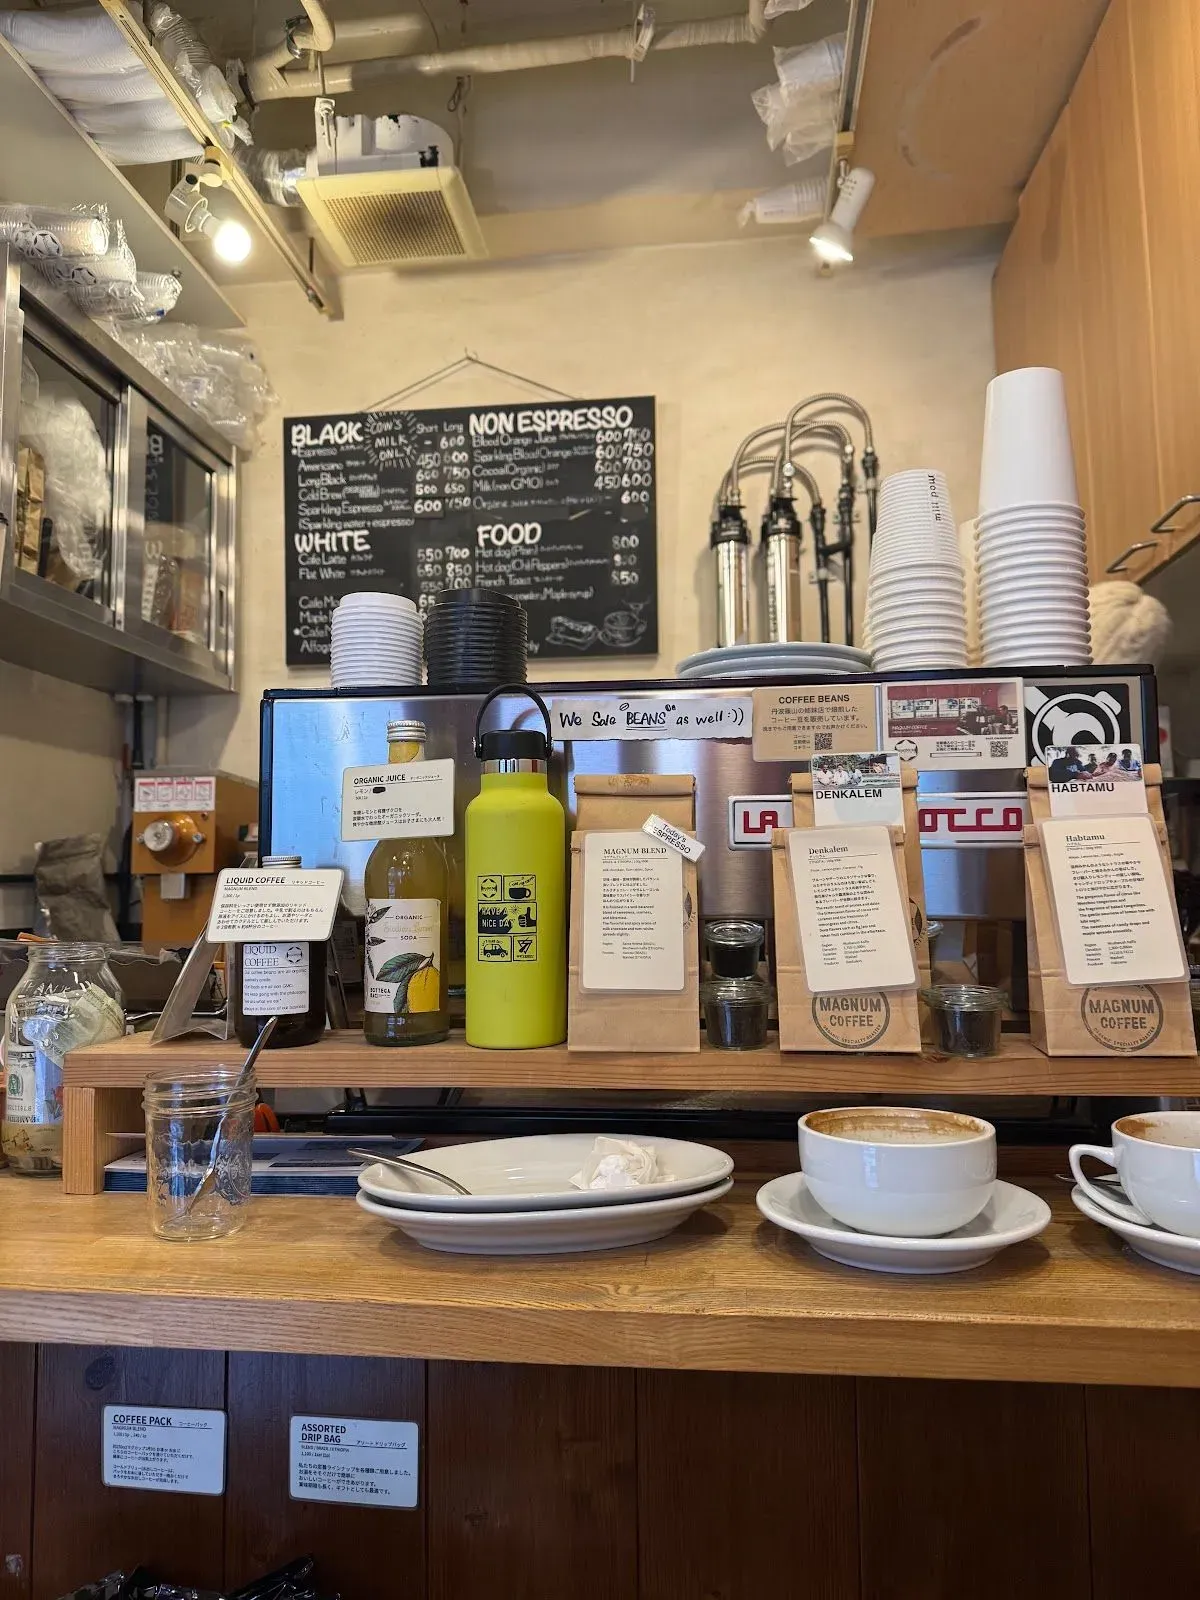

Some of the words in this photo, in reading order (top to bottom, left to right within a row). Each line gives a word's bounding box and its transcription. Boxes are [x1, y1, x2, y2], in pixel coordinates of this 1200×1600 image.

[468, 412, 514, 435] NON
[517, 405, 634, 433] ESPRESSO
[291, 421, 364, 448] BLACK
[374, 434, 408, 448] MILK
[595, 431, 621, 444] 600
[440, 436, 465, 449] 600
[378, 445, 413, 461] ONLY
[595, 445, 621, 459] 600
[416, 452, 440, 469] 450
[595, 462, 621, 474] 600
[622, 457, 651, 471] 700
[416, 469, 439, 482] 600
[594, 477, 621, 490] 450
[621, 474, 652, 488] 600
[620, 490, 650, 504] 600
[413, 500, 443, 514] 600
[294, 529, 371, 553] WHITE
[477, 522, 542, 547] FOOD
[416, 548, 443, 561] 550
[445, 546, 471, 560] 700
[778, 695, 815, 704] COFFEE
[818, 694, 850, 703] BEANS
[559, 711, 582, 728] We
[626, 711, 666, 725] BEANS
[676, 715, 689, 725] as
[695, 710, 724, 726] well
[353, 776, 384, 785] ORGANIC
[385, 774, 406, 782] JUICE
[815, 789, 883, 800] DENKALEM
[1051, 782, 1115, 793] HABTAMU
[743, 810, 778, 834] LA
[652, 825, 691, 854] ESPRESSO
[1065, 834, 1105, 842] Habtamu
[808, 846, 849, 855] Denkalem
[226, 876, 254, 885] LIQUID
[255, 876, 287, 884] COFFEE
[482, 919, 497, 928] NICE
[244, 945, 277, 956] LIQUID
[244, 957, 280, 967] COFFEE
[819, 997, 881, 1013] MAGNUM
[1089, 999, 1155, 1014] MAGNUM
[829, 1014, 874, 1027] COFFEE
[1100, 1016, 1148, 1030] COFFEE
[113, 1414, 147, 1425] COFFEE
[149, 1416, 173, 1426] PACK
[301, 1423, 347, 1434] ASSORTED
[301, 1432, 322, 1442] DRIP
[324, 1434, 341, 1443] BAG
